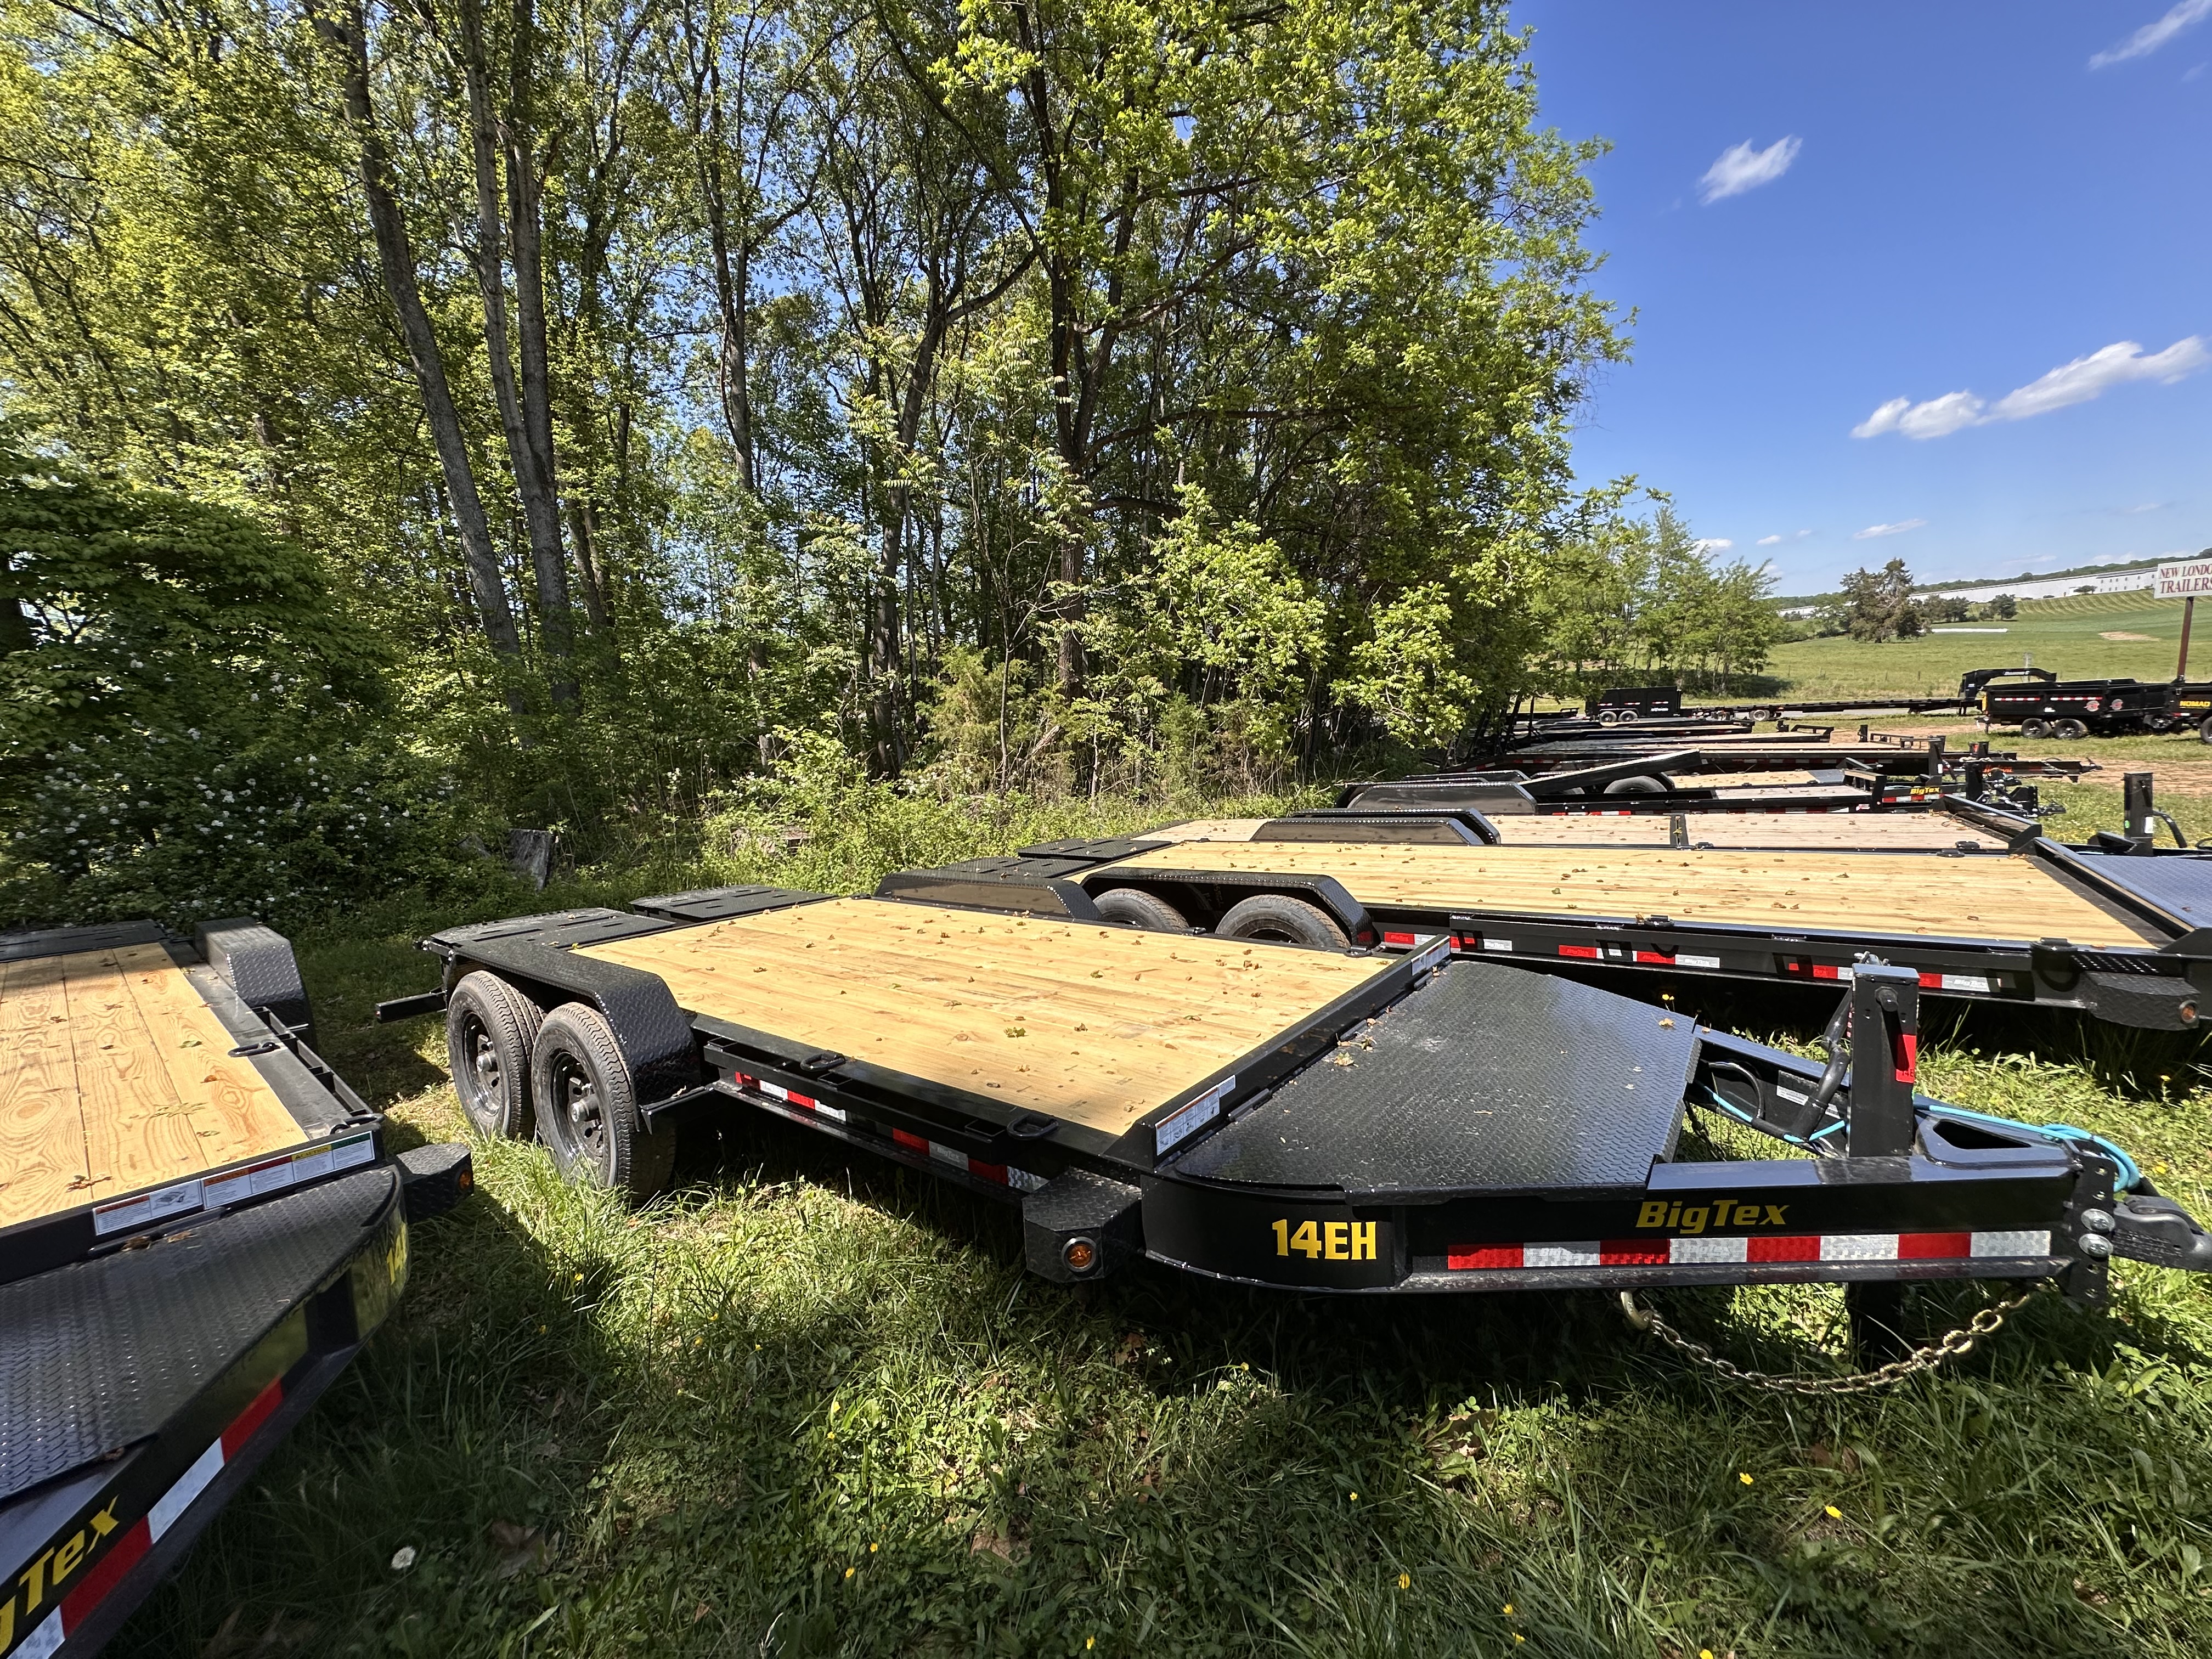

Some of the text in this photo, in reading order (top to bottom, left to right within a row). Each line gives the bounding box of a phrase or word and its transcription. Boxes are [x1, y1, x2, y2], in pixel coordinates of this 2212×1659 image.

[2159, 566, 2180, 579] NEW
[1910, 787, 1940, 795] BigTex
[300, 1146, 329, 1158] CAUTION
[1635, 1200, 1790, 1234] BigTex
[1272, 1219, 1377, 1260] 14EH
